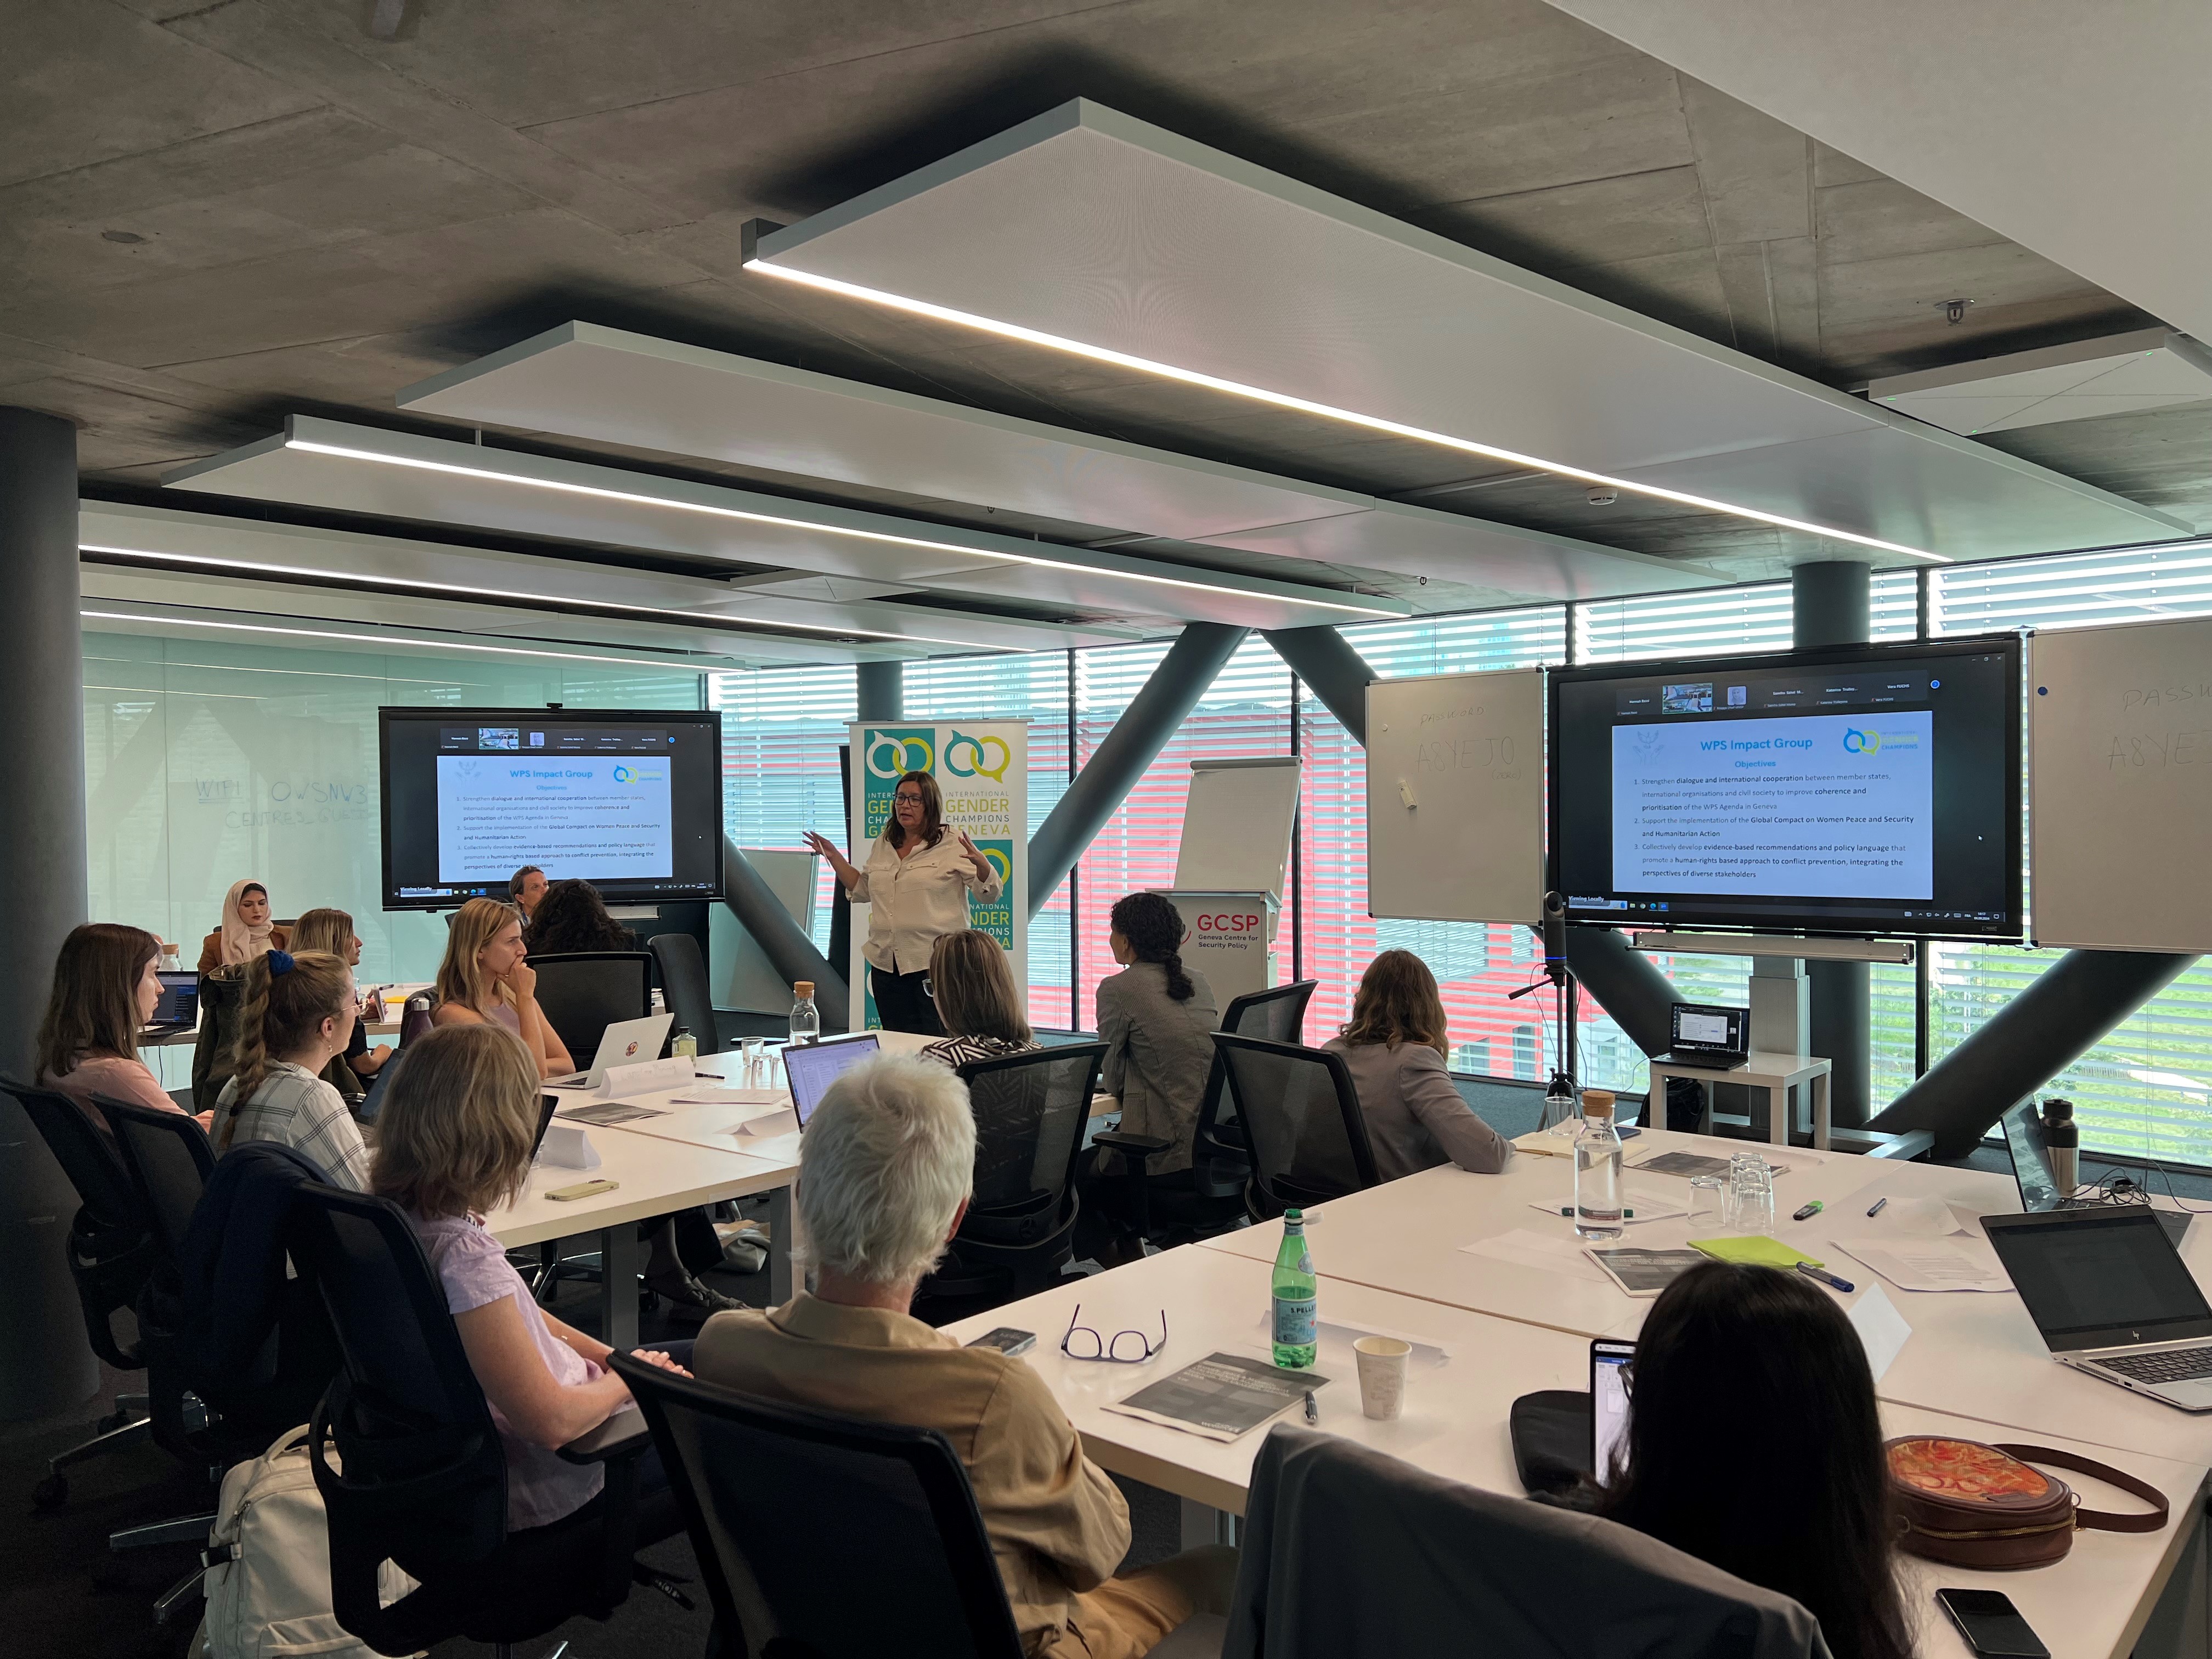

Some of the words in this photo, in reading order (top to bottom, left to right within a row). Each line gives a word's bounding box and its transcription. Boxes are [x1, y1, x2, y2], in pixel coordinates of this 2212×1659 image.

[2123, 684, 2212, 712] PASSW
[1420, 707, 1483, 726] PASSWORD
[1700, 740, 1727, 751] WPS
[1730, 739, 1771, 752] Impact
[1774, 738, 1813, 750] Group
[2108, 731, 2212, 771] A8YE
[1735, 760, 1776, 769] Objectives
[533, 770, 563, 778] Impact
[565, 770, 592, 778] Group
[196, 778, 239, 797] WIFI
[946, 799, 1009, 812] GENDER
[946, 815, 1009, 823] CHAMPIONS
[1884, 815, 1914, 823] Security
[1675, 856, 1717, 865] human-rights
[1850, 859, 1889, 867] integrating
[970, 911, 1009, 926] NDER
[1197, 914, 1259, 932] GCSP
